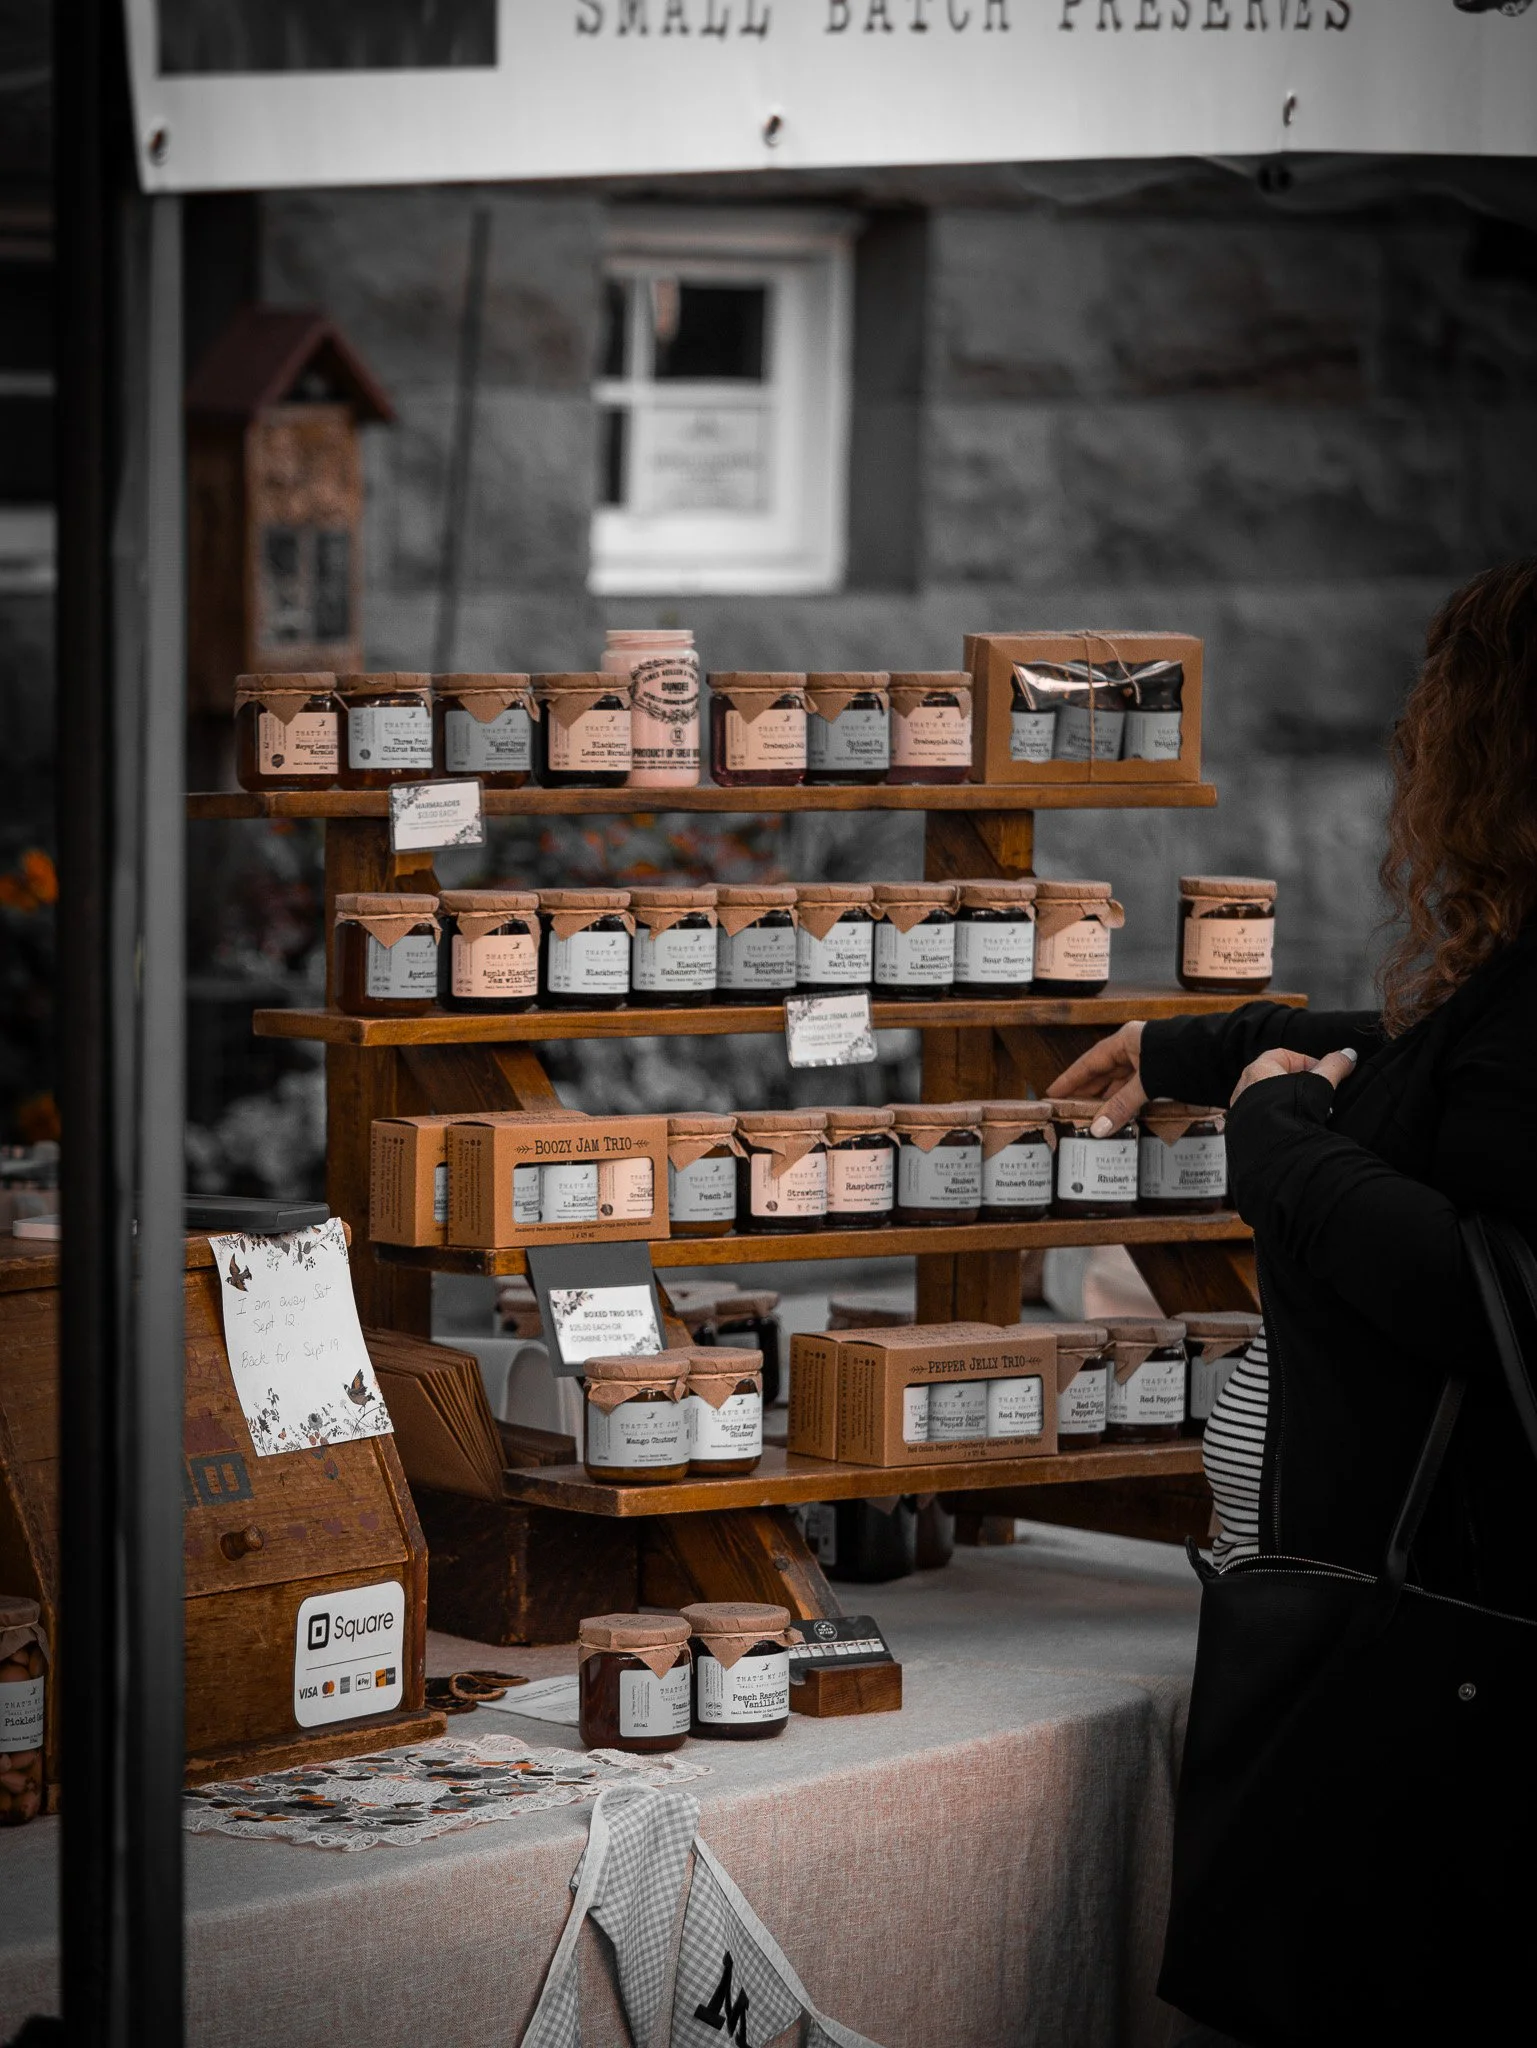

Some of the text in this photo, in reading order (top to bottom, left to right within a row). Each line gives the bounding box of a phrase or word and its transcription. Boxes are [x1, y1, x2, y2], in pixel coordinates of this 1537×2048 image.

[575, 0, 770, 41] SMALL
[1057, 0, 1352, 32] PRESERVES
[534, 1136, 633, 1155] BOOZY JAM TRIO
[845, 1181, 886, 1192] Raspberry
[236, 1283, 332, 1316] I am away Sat
[584, 1309, 643, 1319] BOXED TRIO SETS
[592, 1323, 611, 1332] EACH
[571, 1335, 602, 1343] COMBINE
[608, 1334, 621, 1342] FOR
[241, 1350, 270, 1370] Back
[275, 1343, 290, 1365] for
[928, 1355, 1026, 1375] PEPPER JELLY TRIO
[1139, 1395, 1177, 1404] Red Pepper
[1076, 1401, 1089, 1410] Red
[999, 1410, 1037, 1420] Red Pepper
[1071, 1408, 1094, 1418] Pepper
[721, 1424, 741, 1432] Spicy
[626, 1436, 678, 1446] Mango Chutney
[334, 1612, 394, 1643] Square
[736, 1675, 764, 1683] THAT'S
[767, 1672, 776, 1680] MY
[299, 1685, 318, 1700] VISA
[733, 1693, 758, 1701] Peach
[744, 1697, 776, 1709] Vanilla
[4, 1713, 36, 1727] Pickled
